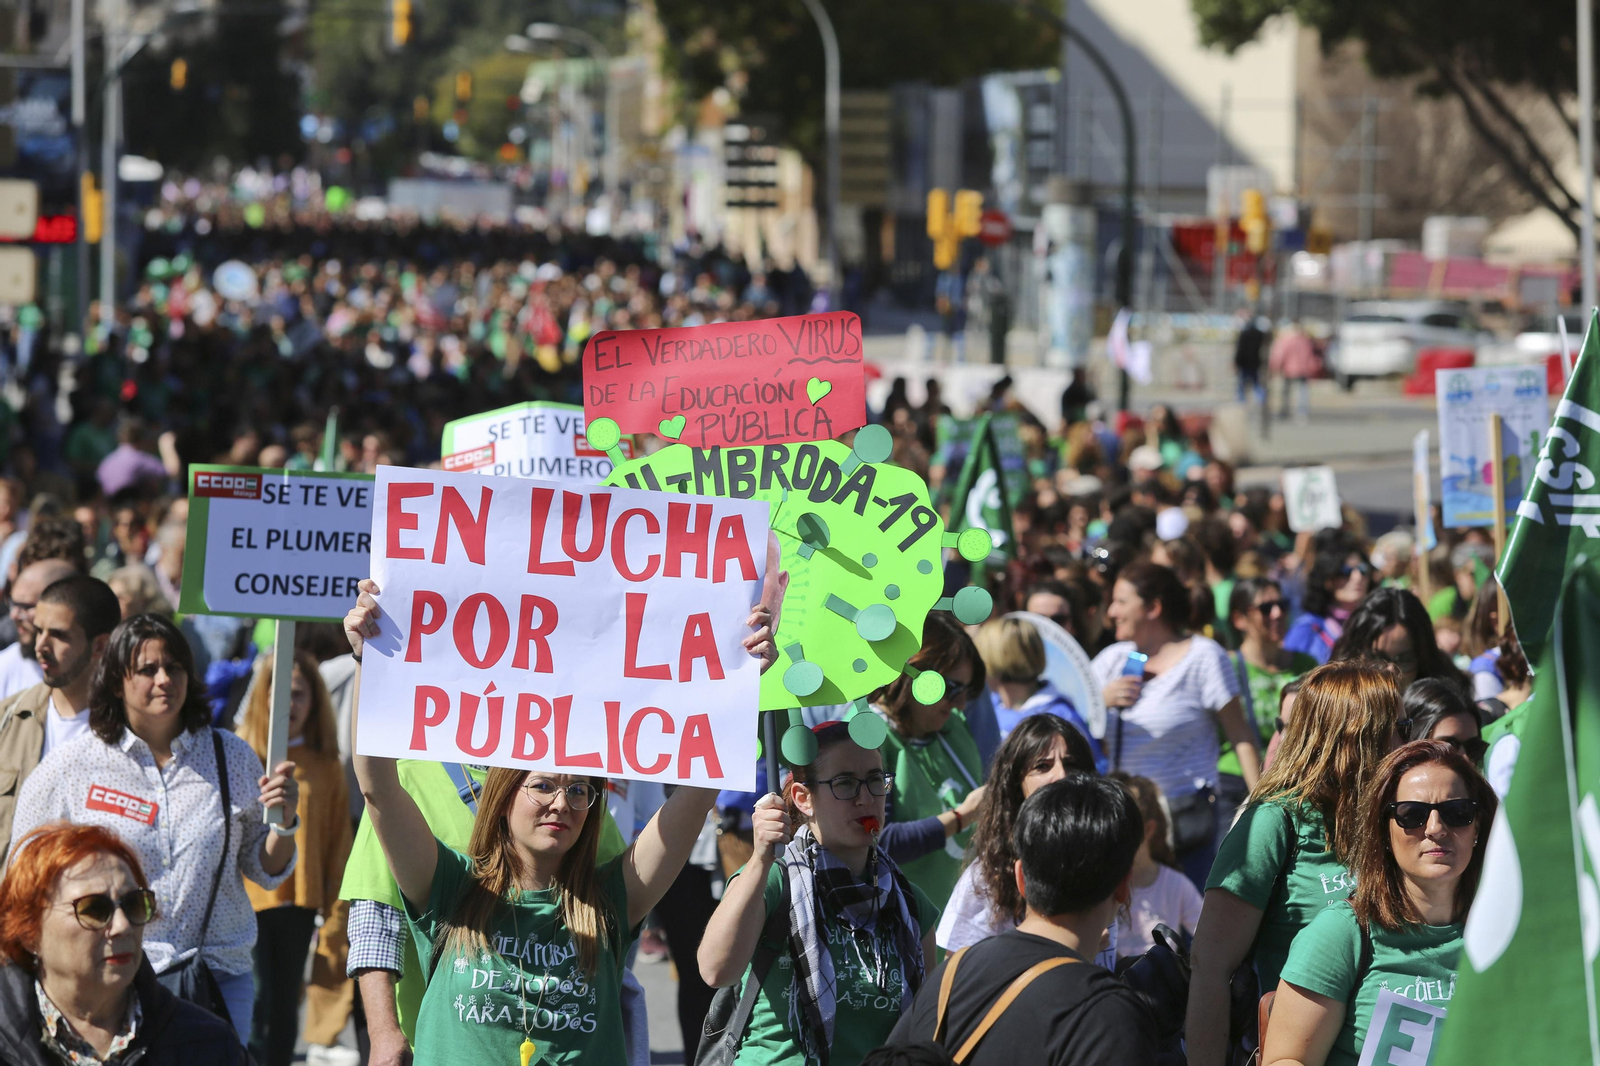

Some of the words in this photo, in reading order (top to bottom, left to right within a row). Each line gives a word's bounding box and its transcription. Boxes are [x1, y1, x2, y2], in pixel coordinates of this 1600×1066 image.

[595, 335, 632, 371] EL
[641, 333, 777, 366] VERDADERO
[776, 317, 860, 356] VIRUS
[590, 382, 619, 406] DE
[628, 381, 656, 402] LA
[488, 420, 511, 444] SE
[519, 414, 546, 434] TE
[554, 416, 584, 436] VE
[695, 406, 833, 449] PÚBLICA
[444, 450, 484, 469] CCOO
[197, 474, 246, 489] CCOO
[262, 482, 291, 505] SE
[299, 484, 328, 507] TE
[336, 486, 369, 508] VE
[609, 444, 938, 553] MBRODA-19
[231, 527, 258, 549] EL
[266, 528, 371, 553] PLUMER
[386, 482, 494, 566] EN
[527, 487, 759, 584] LUCHA
[234, 572, 360, 598] CONSEJER
[404, 590, 559, 674] POR
[624, 592, 725, 683] LA
[409, 680, 725, 780] PÚBLICA
[90, 787, 141, 812] CCOO
[534, 937, 577, 968] PÚBLI
[471, 968, 503, 990] DE
[512, 971, 588, 998] TOD@S
[457, 1002, 513, 1024] PARA
[518, 1007, 597, 1033] TOD@S
